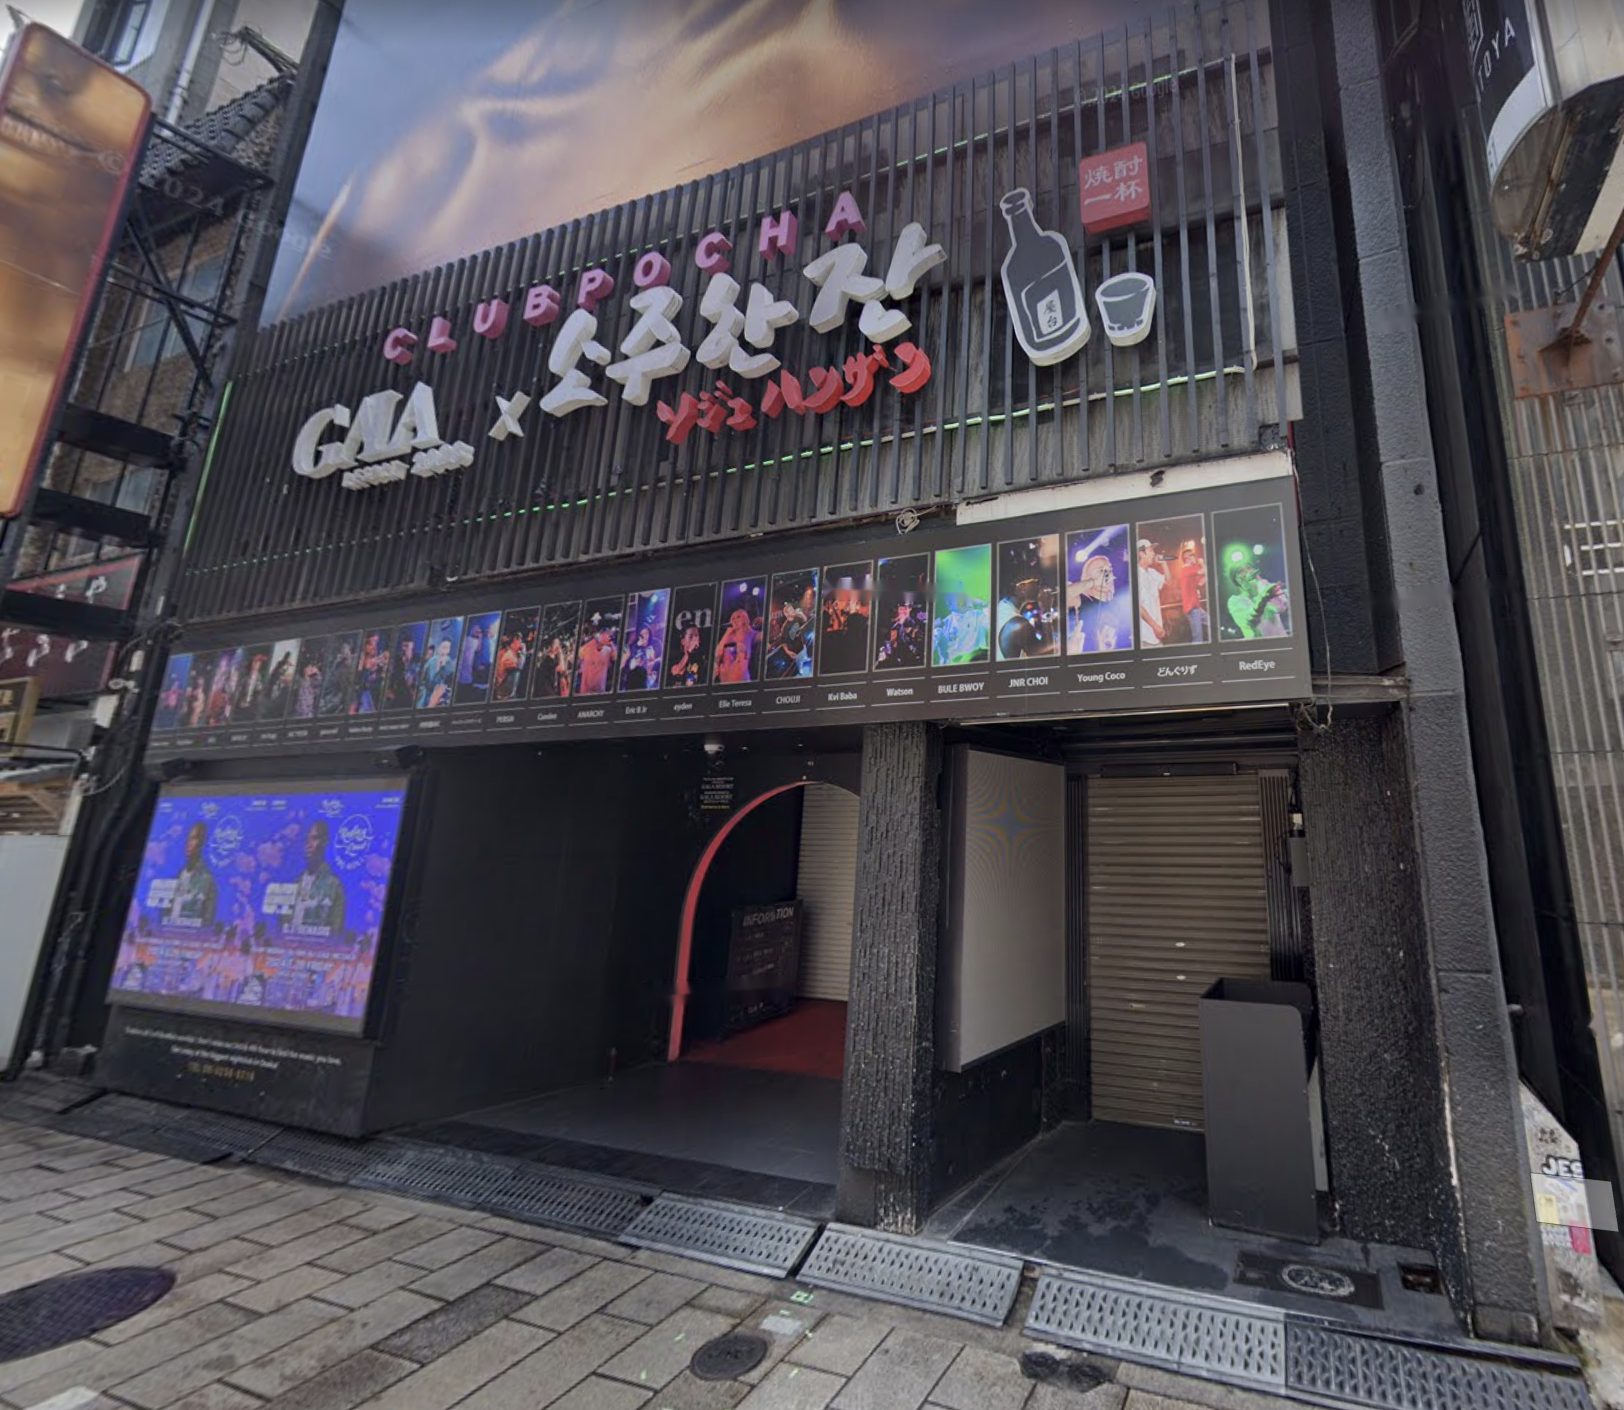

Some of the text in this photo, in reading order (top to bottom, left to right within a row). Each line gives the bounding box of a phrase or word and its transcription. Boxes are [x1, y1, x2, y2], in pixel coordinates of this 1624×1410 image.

[1083, 155, 1144, 190] 焼酎
[1084, 179, 1143, 206] 一杯
[1157, 664, 1198, 677] どんぐりず
[1239, 660, 1276, 671] RedEye
[1008, 676, 1049, 688] JNR CHOI
[1077, 672, 1126, 683] Young Coco
[886, 688, 914, 697] Watson
[959, 682, 985, 692] BWOY
[840, 691, 858, 700] Baba
